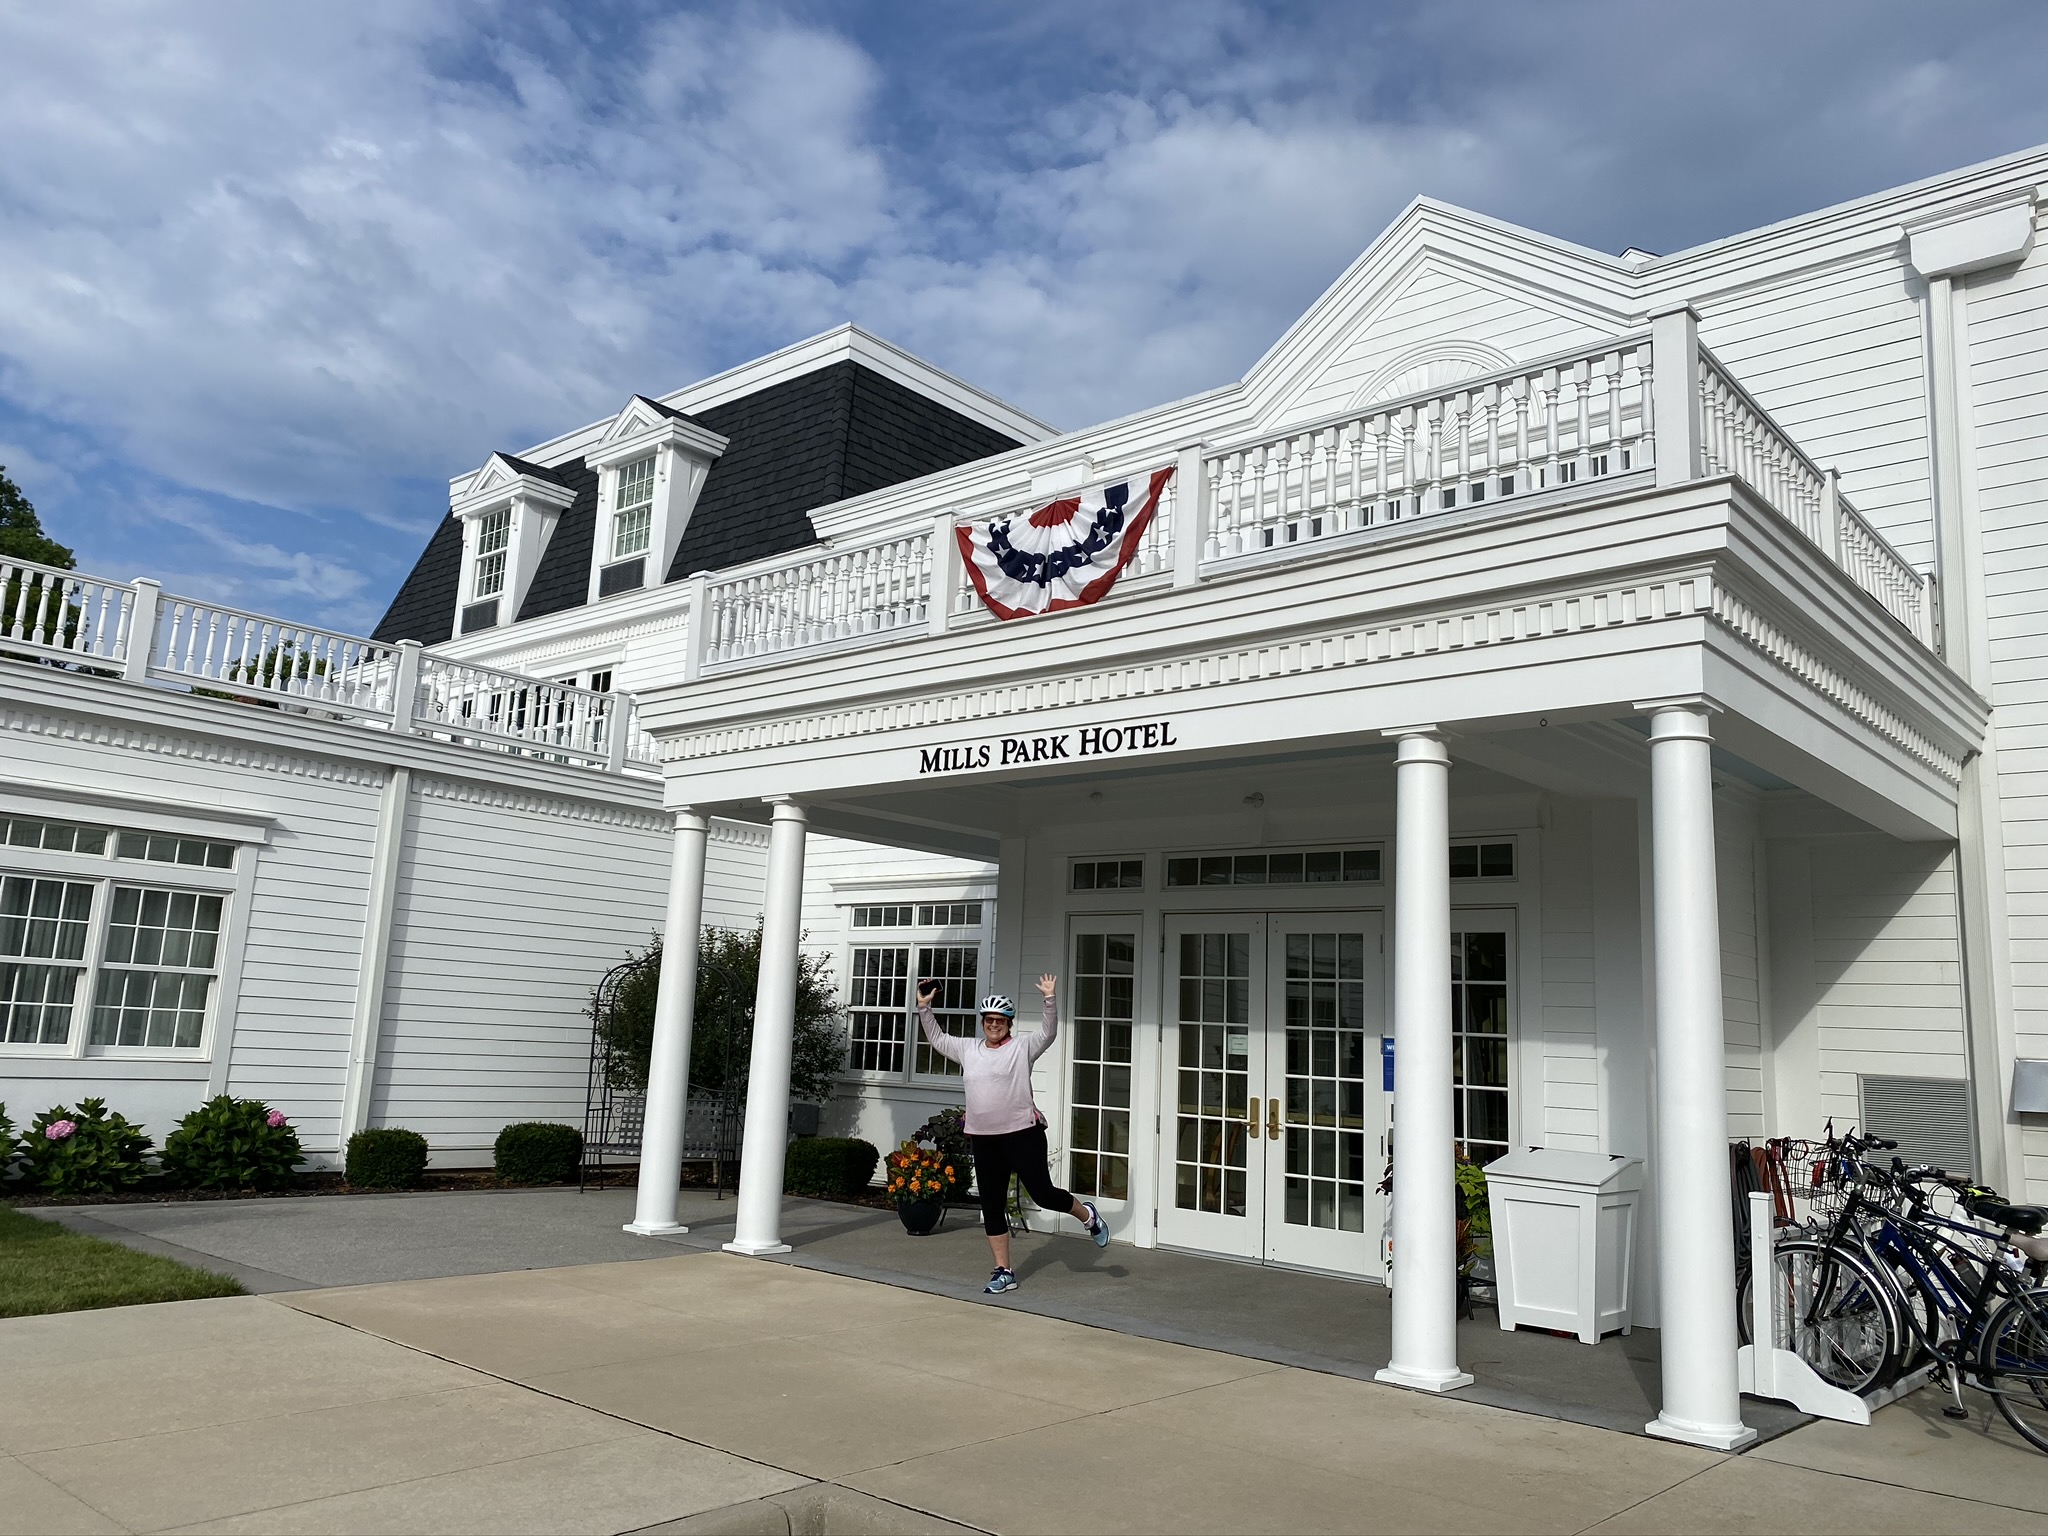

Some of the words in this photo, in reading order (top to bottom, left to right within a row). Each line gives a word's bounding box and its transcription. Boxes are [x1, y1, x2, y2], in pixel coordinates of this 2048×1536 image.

[919, 745, 990, 773] MILLS
[1000, 734, 1069, 765] PARK
[1079, 722, 1177, 756] HOTEL
